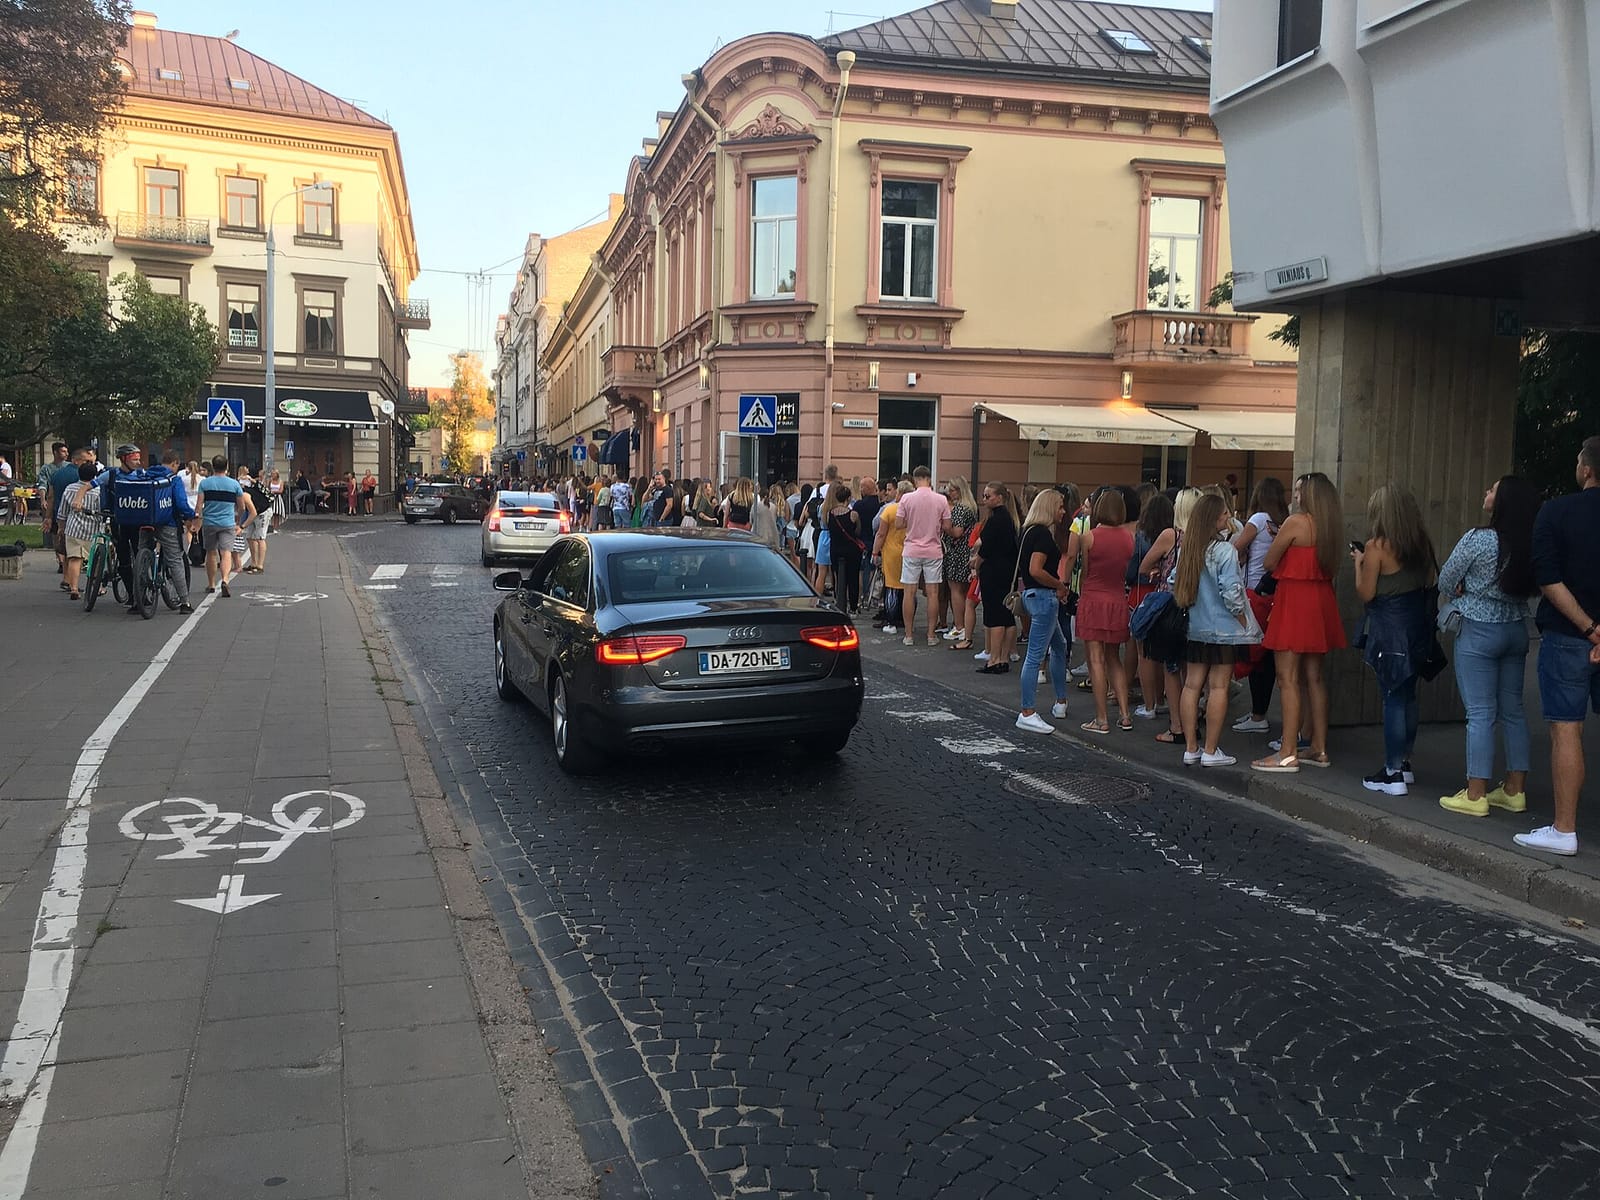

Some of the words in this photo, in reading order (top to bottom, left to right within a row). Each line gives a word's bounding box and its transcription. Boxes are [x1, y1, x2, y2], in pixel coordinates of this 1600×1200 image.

[1276, 266, 1305, 284] VILNIAUS
[118, 496, 148, 509] Wolt
[711, 651, 780, 669] DA-720-NE
